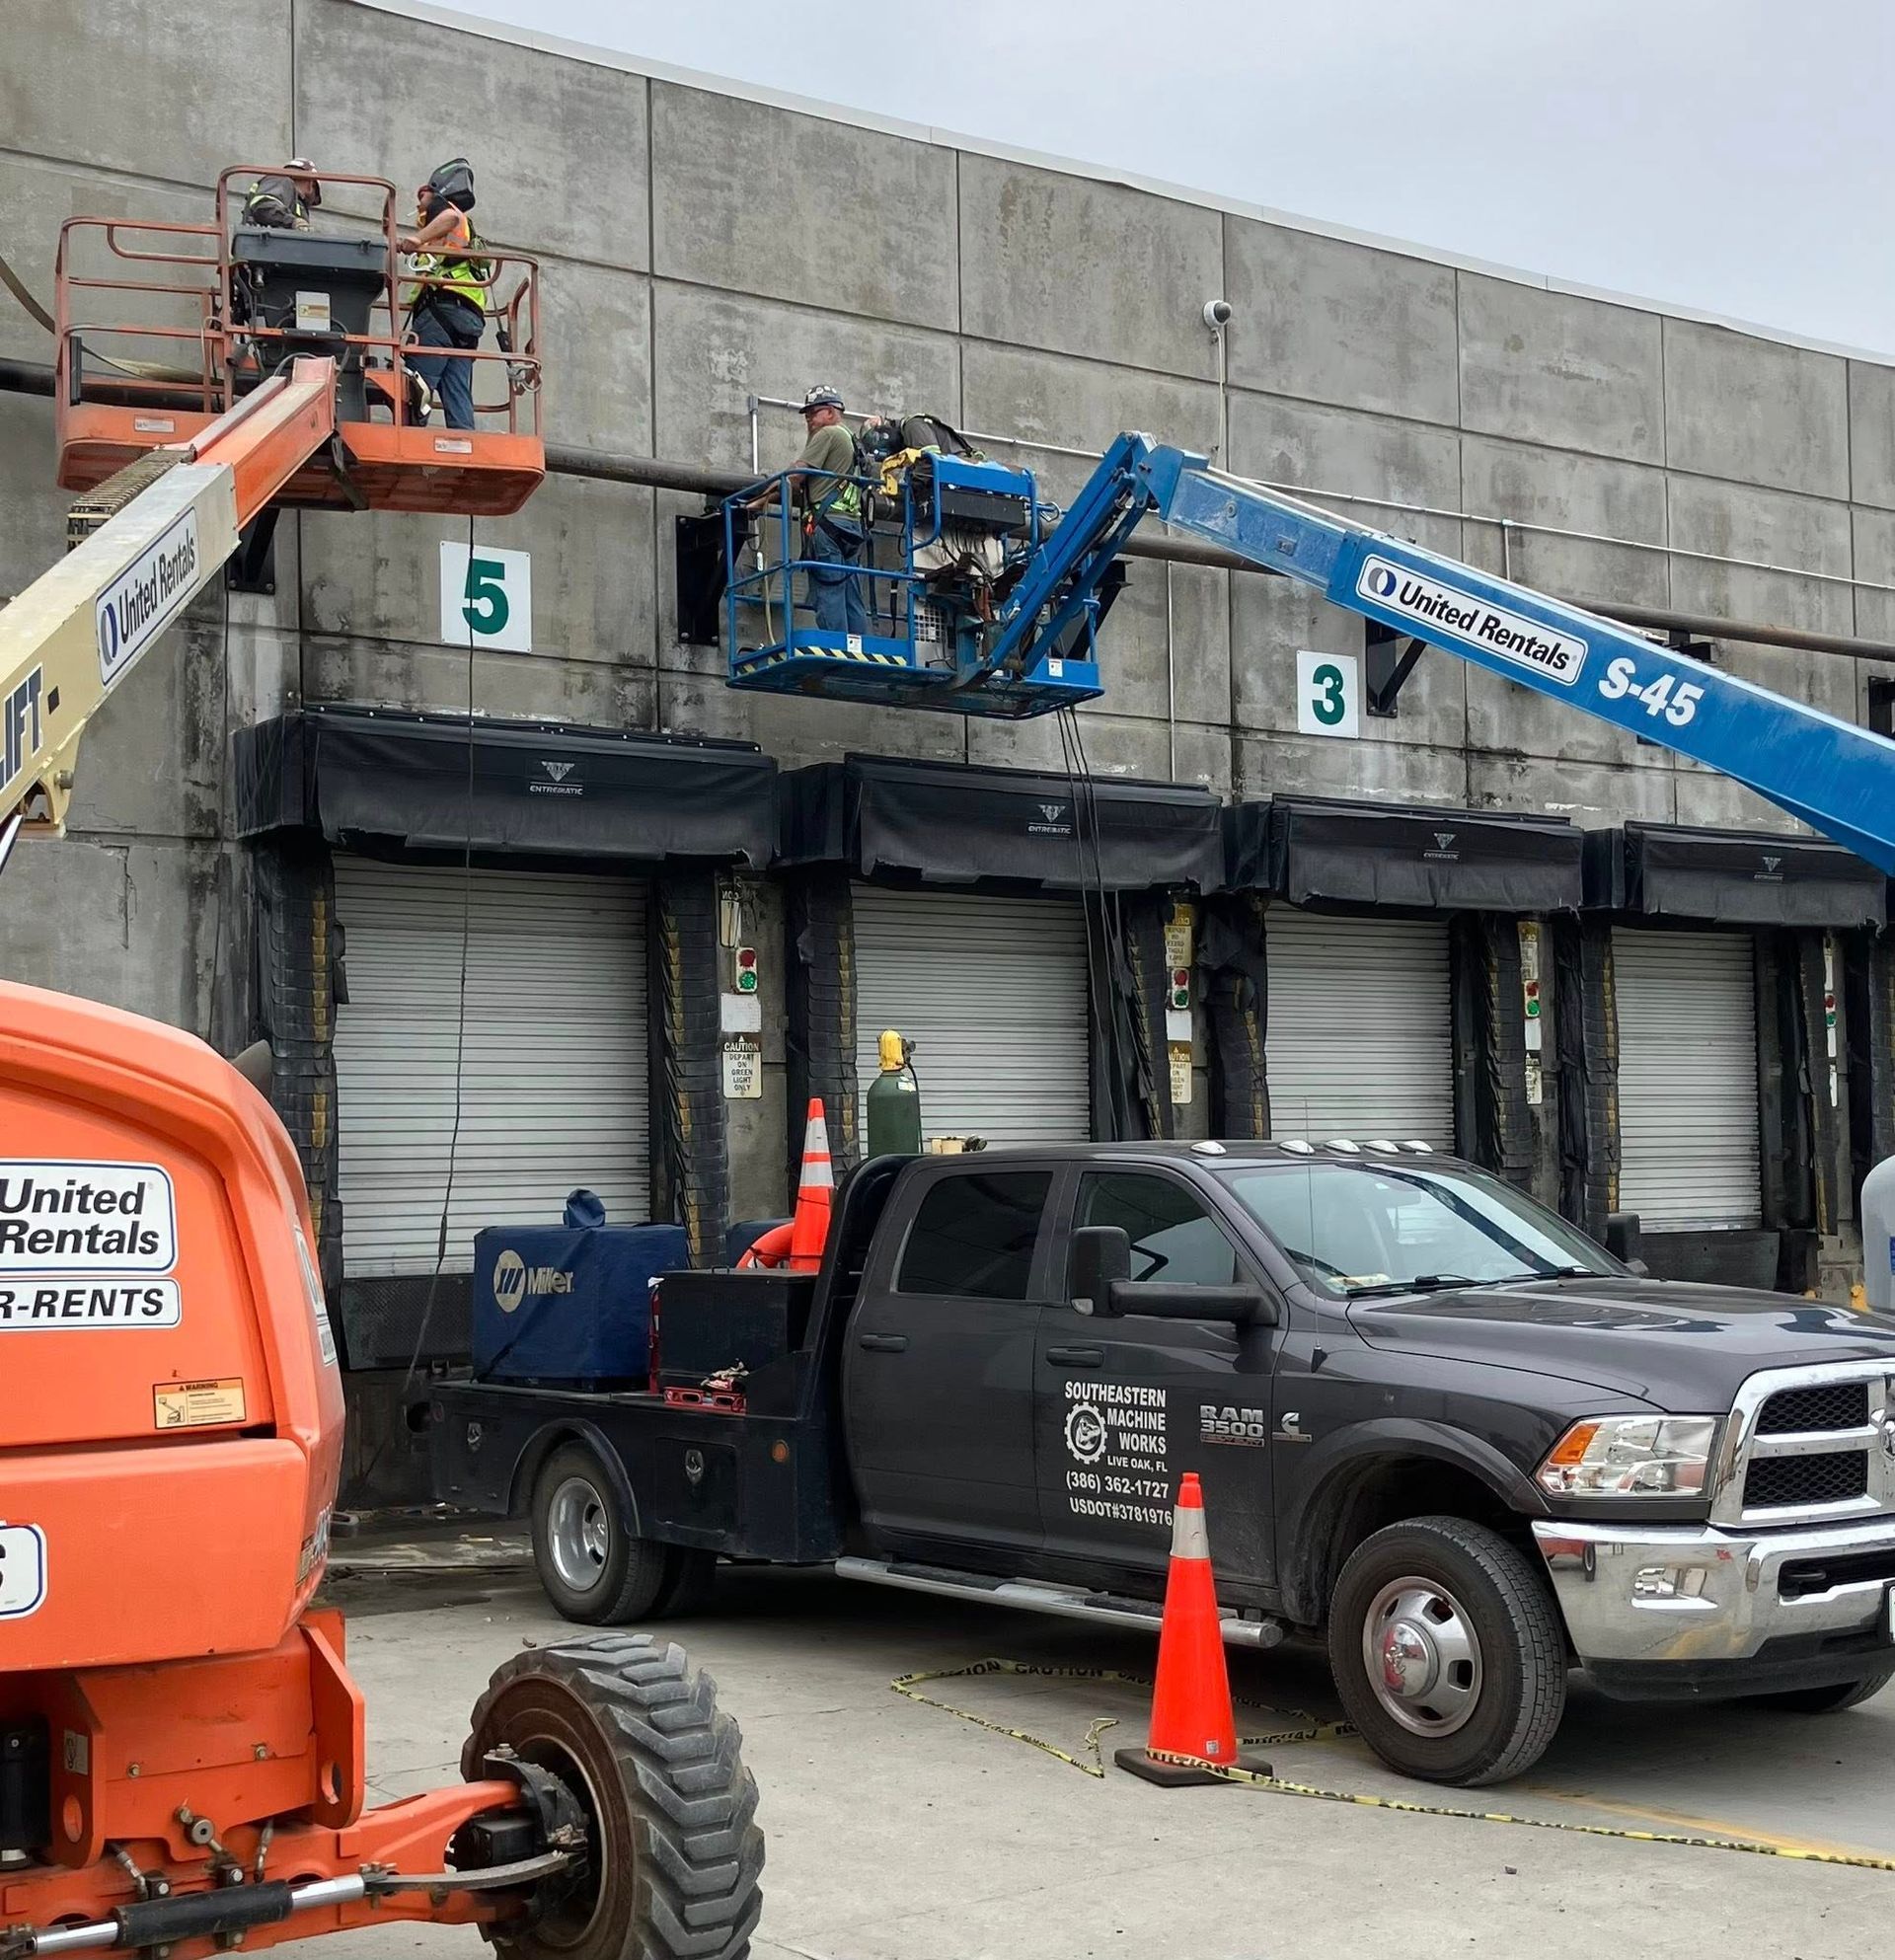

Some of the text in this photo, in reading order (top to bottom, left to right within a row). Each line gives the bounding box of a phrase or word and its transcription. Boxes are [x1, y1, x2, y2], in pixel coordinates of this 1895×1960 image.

[118, 528, 195, 643] United Rentals
[462, 559, 509, 635] 5
[1400, 580, 1570, 670] United Rentals
[1312, 664, 1345, 724] 3
[1598, 656, 1706, 726] S-45
[0, 664, 42, 792] IFT
[529, 785, 584, 795] ENTREMATIC
[723, 1042, 760, 1052] CAUTION
[0, 1178, 146, 1215] United
[0, 1219, 160, 1255] Rentals
[527, 1266, 574, 1295] Miller
[186, 1382, 219, 1392] WARNING
[1064, 1381, 1167, 1408] SOUTHEASTERN
[1106, 1407, 1167, 1432] MACHINE
[1199, 1404, 1264, 1424] RAM
[1200, 1419, 1264, 1438] 3500
[1118, 1431, 1167, 1456] WORKS
[1106, 1455, 1169, 1472] LIVE OAK, FL
[1066, 1470, 1170, 1499] (386) 362-1727
[1069, 1496, 1174, 1527] USDOT#3781976
